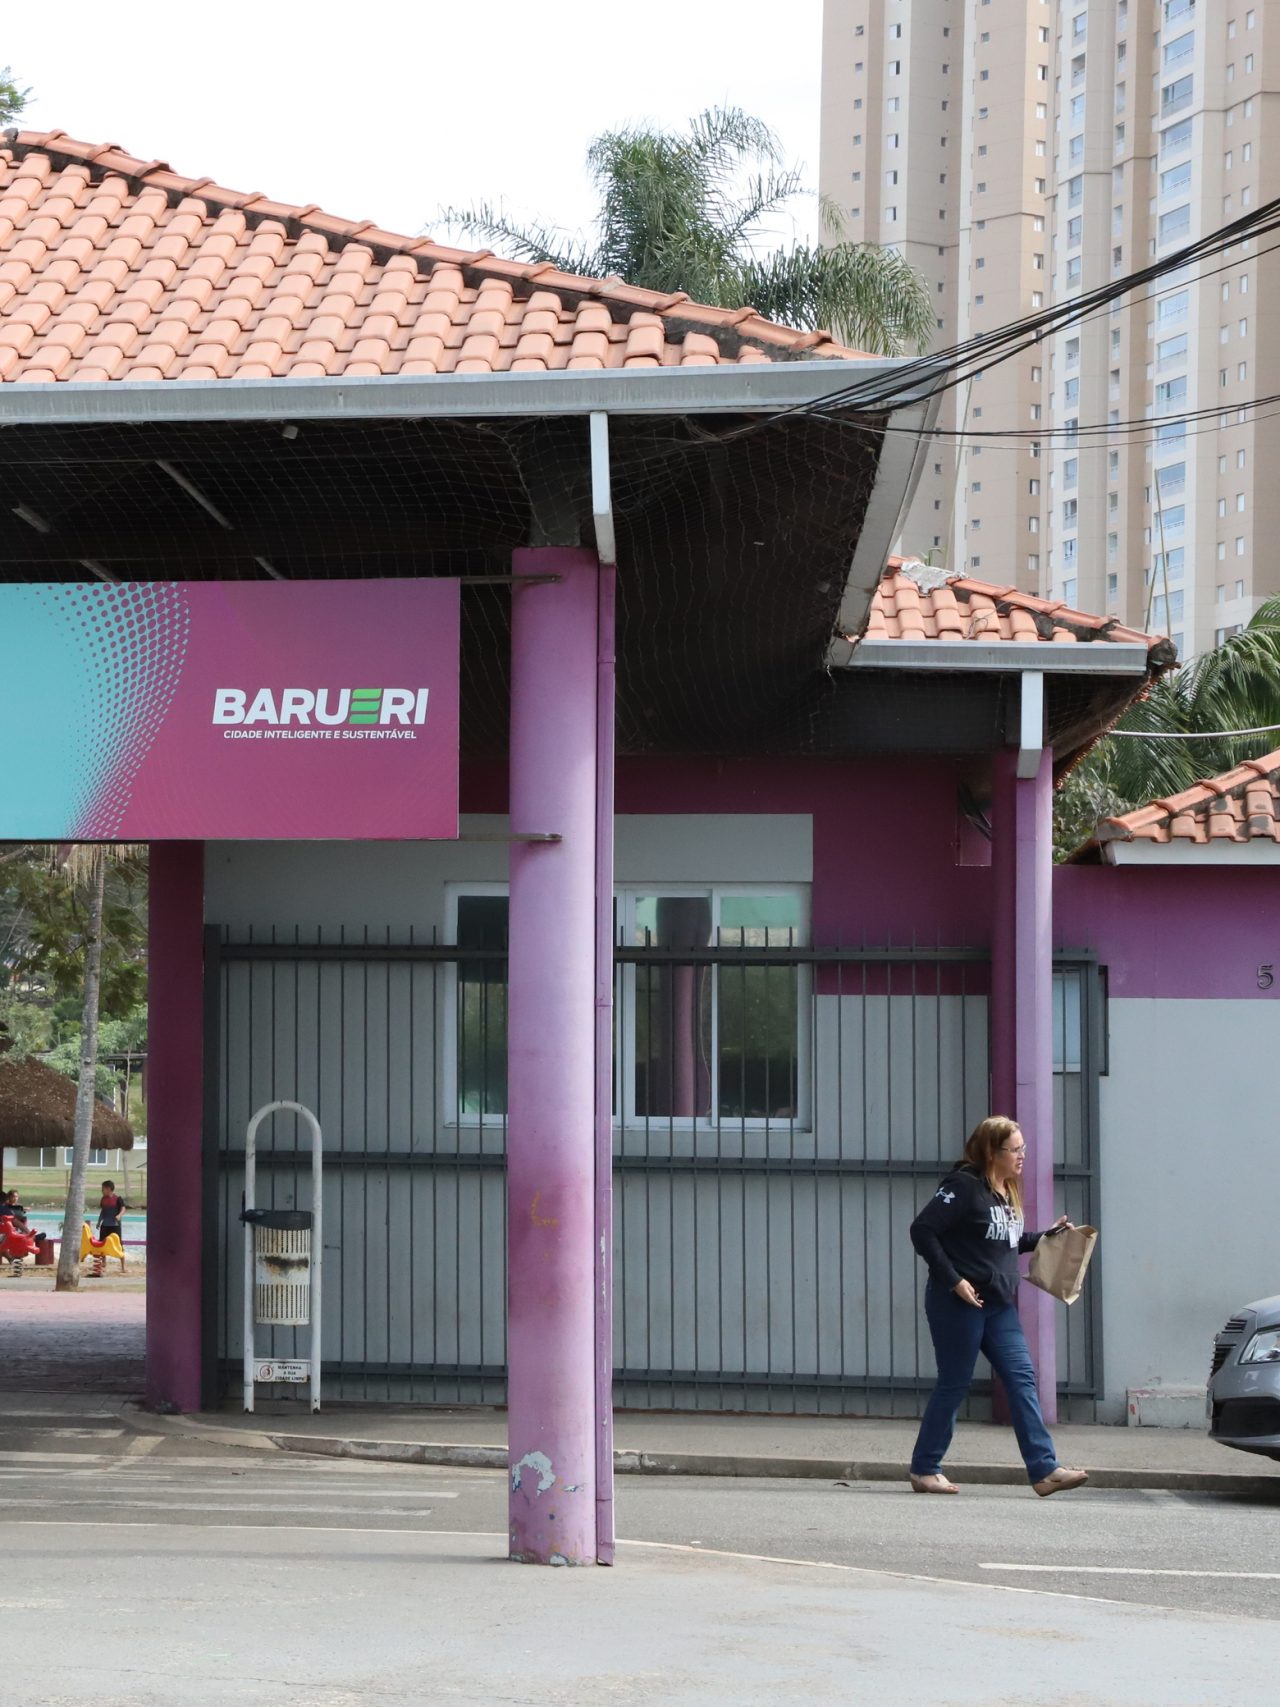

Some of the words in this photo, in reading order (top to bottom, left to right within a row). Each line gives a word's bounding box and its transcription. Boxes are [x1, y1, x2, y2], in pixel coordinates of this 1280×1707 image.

[212, 688, 429, 725] BARUERI
[223, 730, 263, 739] CIDADE
[264, 730, 332, 739] INTELIGENTE
[333, 730, 340, 739] E
[342, 728, 417, 739] SUSTENTÁVEL
[1257, 965, 1274, 990] 5
